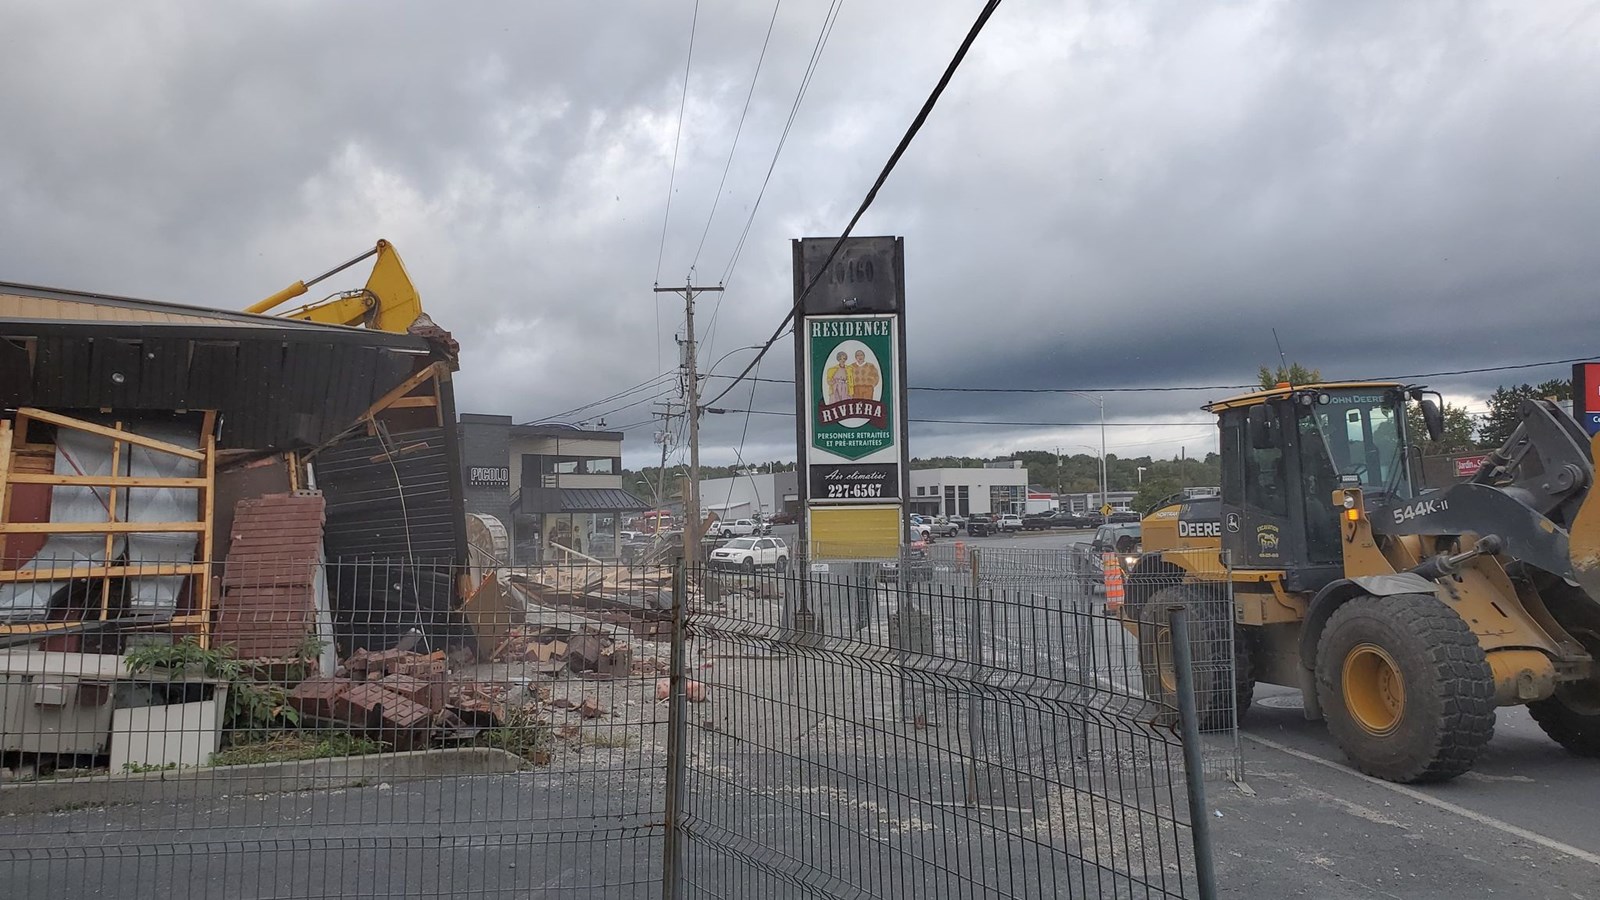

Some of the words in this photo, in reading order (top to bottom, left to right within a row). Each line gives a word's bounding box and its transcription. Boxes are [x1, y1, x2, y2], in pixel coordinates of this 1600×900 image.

[812, 321, 888, 337] RESIDENCE
[1353, 395, 1384, 403] DEERE
[824, 469, 843, 480] Air
[828, 483, 882, 498] 227-6567
[1178, 520, 1222, 537] DEERE
